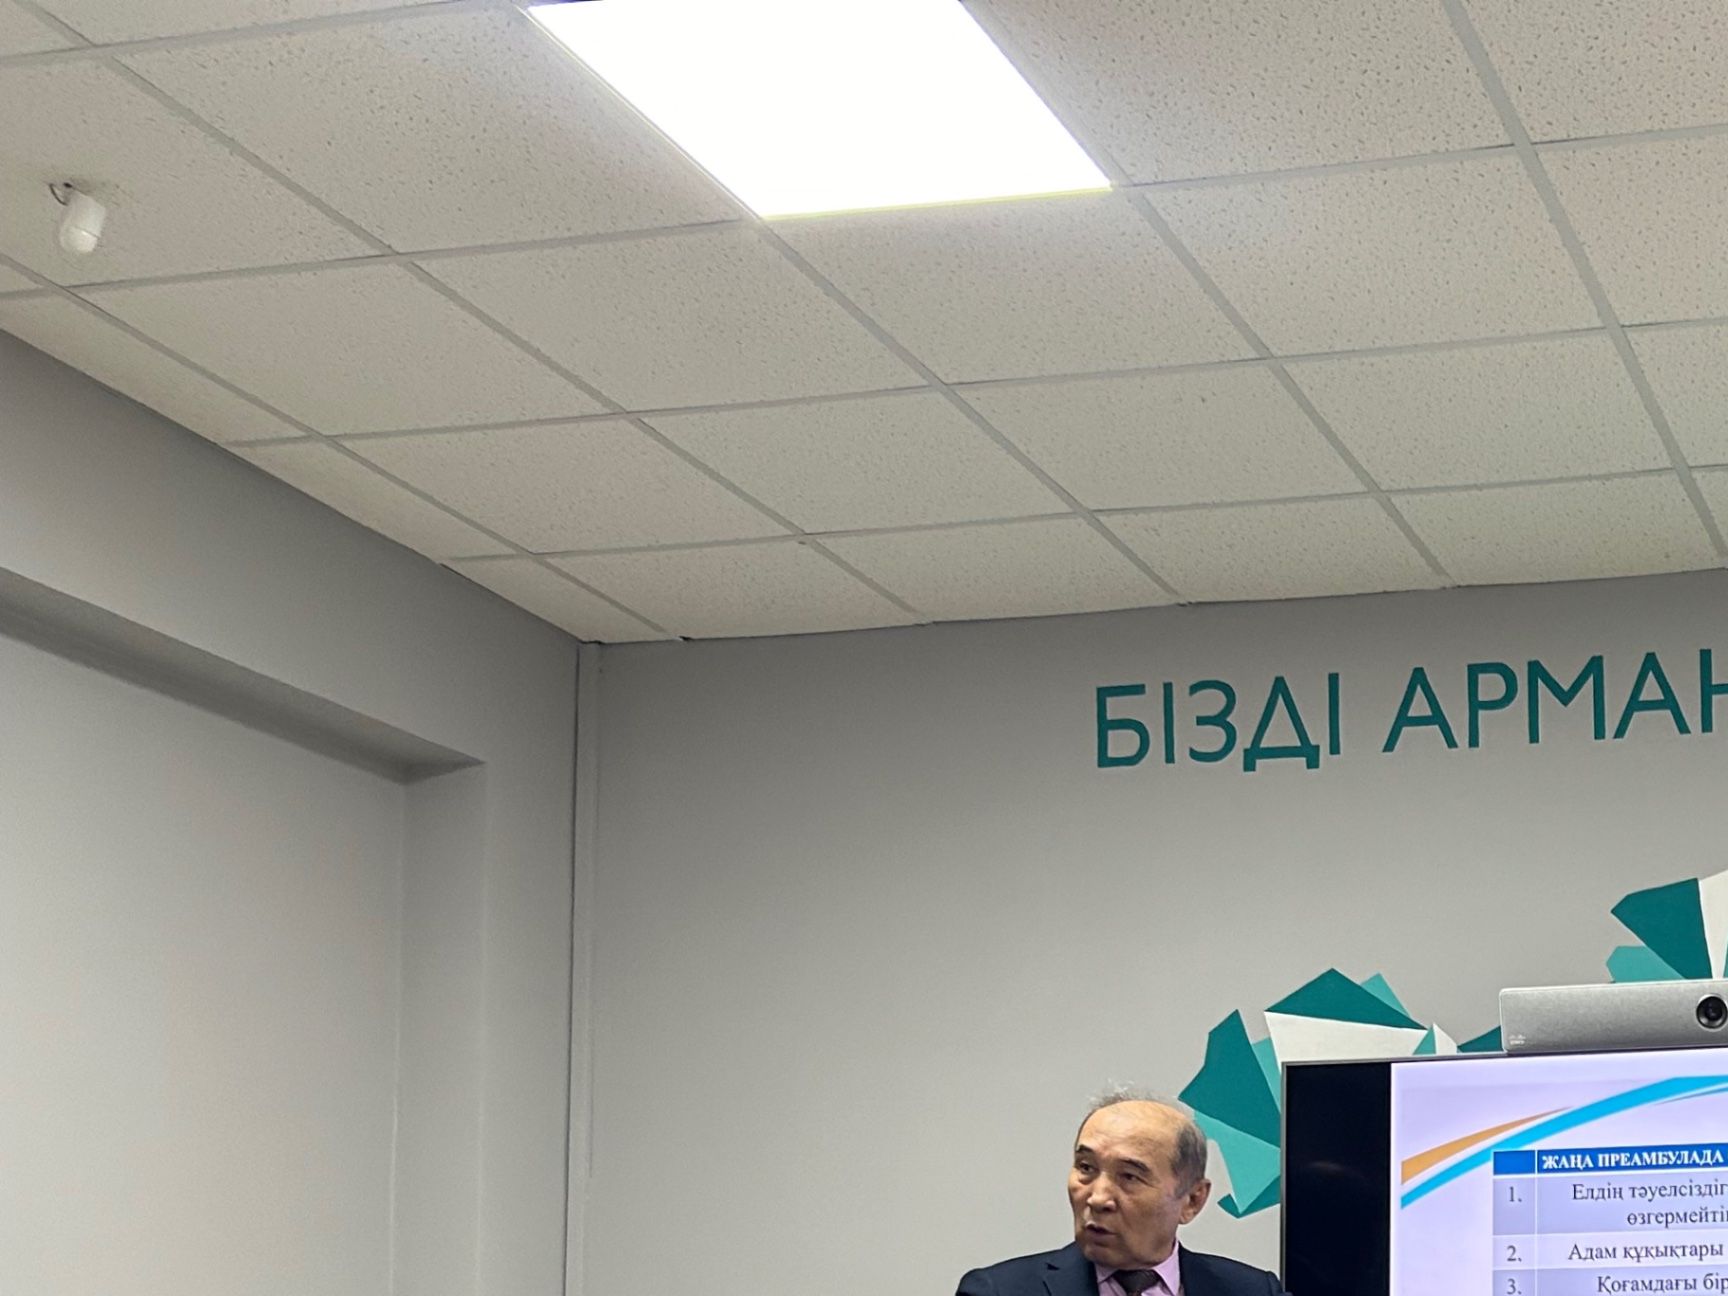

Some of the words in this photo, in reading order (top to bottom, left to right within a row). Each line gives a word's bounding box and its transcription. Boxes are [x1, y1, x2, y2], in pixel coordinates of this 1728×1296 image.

[1096, 672, 1341, 772] БІЗДІ
[1542, 1155, 1594, 1171] ЖАҢА
[1597, 1149, 1724, 1167] ПРЕАМБУЛАДА
[1507, 1186, 1523, 1203] 1.
[1571, 1182, 1624, 1201] Елдің
[1506, 1245, 1523, 1262] 2.
[1567, 1244, 1618, 1261] Адам
[1623, 1243, 1724, 1263] құқықтары
[1506, 1279, 1523, 1295] 3.
[1597, 1276, 1698, 1296] Қоғамдағы
